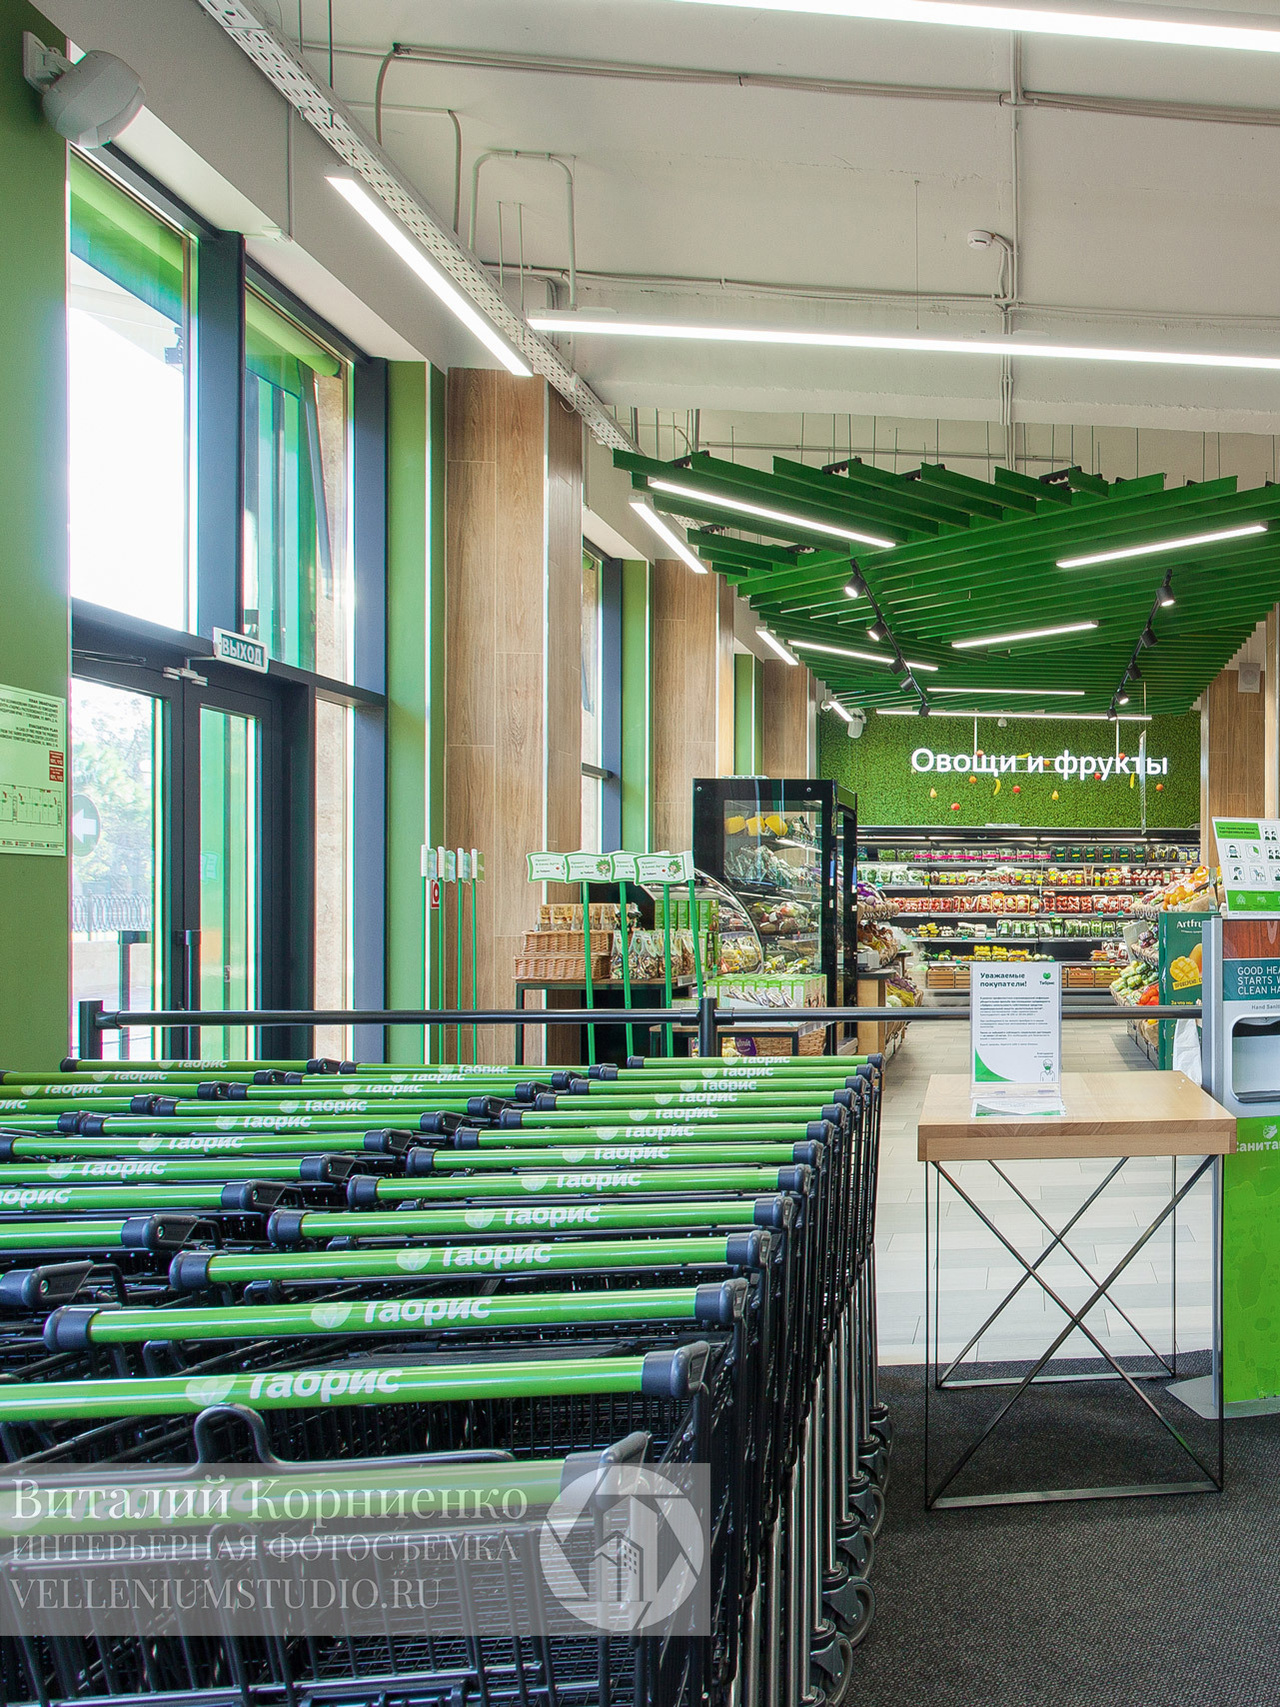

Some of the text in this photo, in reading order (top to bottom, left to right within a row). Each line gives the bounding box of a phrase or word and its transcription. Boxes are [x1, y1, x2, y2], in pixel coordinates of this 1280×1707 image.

[222, 637, 263, 666] ВЫХОД
[911, 748, 1168, 781] Овощи и фрукты
[1237, 966, 1264, 976] GOOD
[1237, 975, 1273, 986] STARTS
[1237, 986, 1268, 996] CLEAN
[702, 1079, 757, 1091] Табрис
